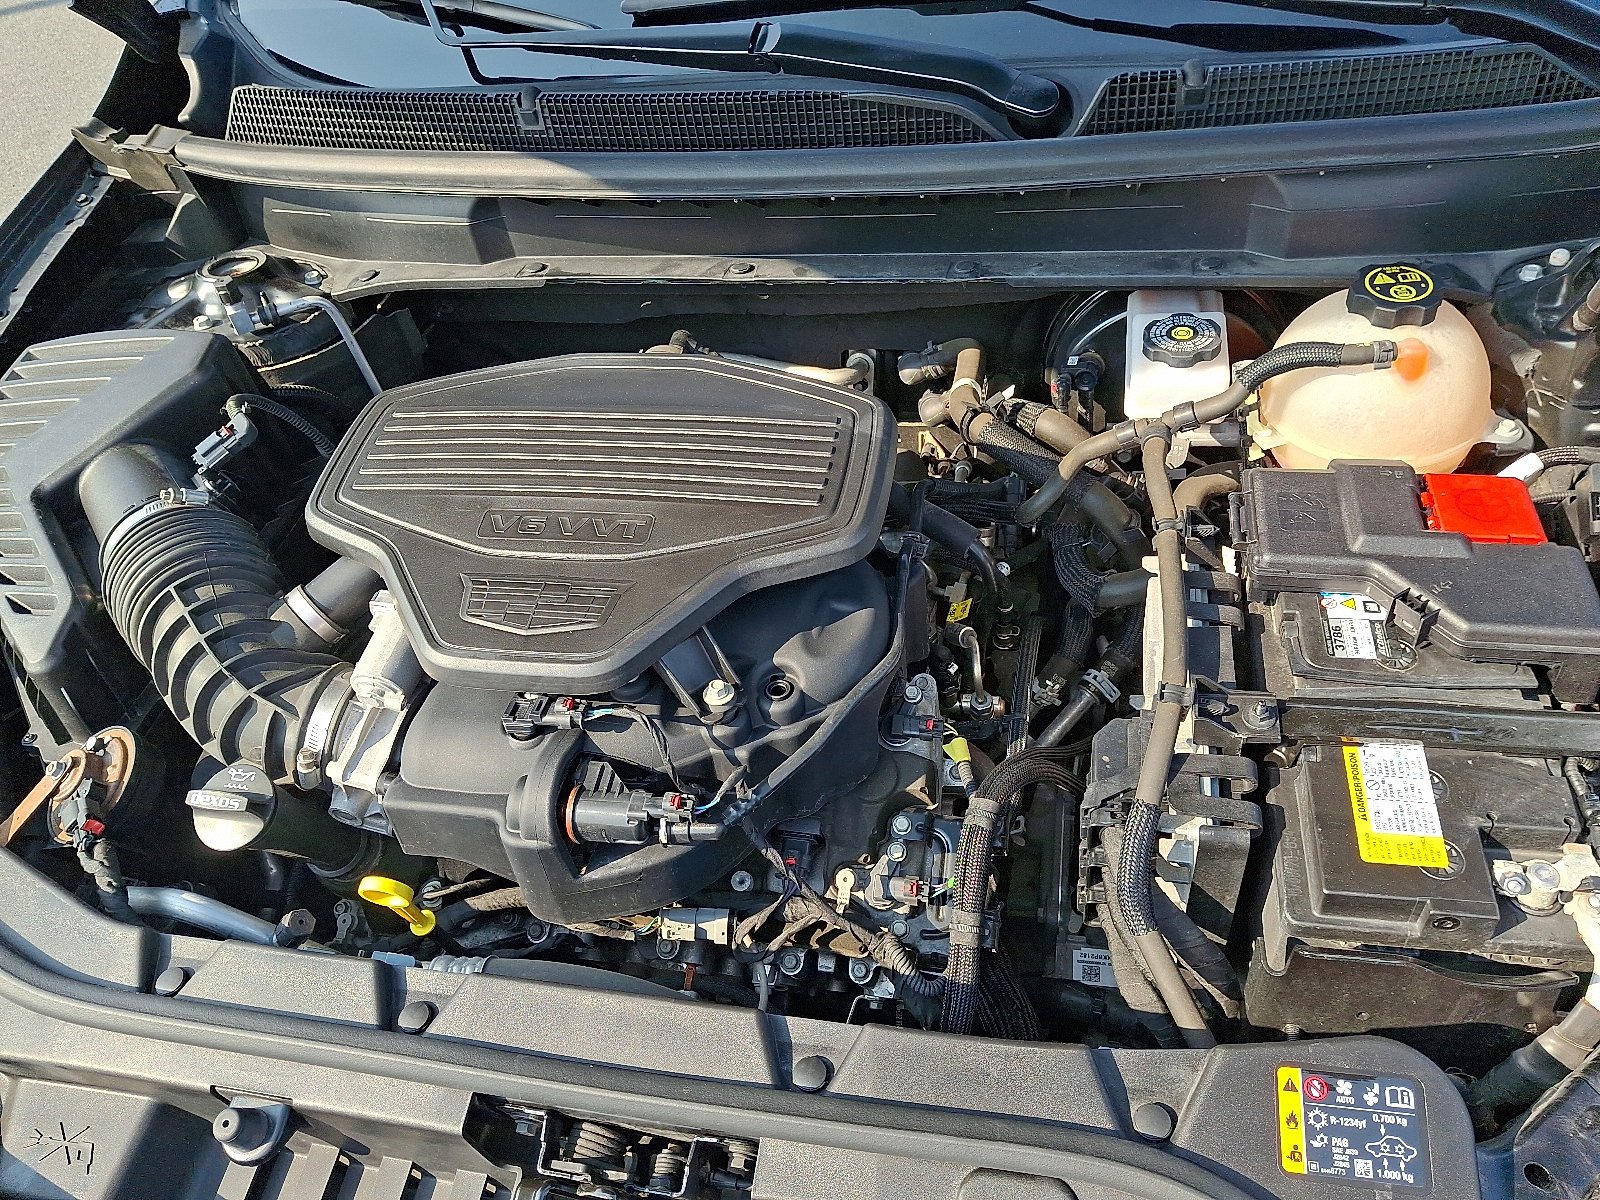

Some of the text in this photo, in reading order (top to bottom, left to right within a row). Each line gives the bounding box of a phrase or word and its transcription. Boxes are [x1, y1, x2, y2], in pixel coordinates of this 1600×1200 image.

[490, 514, 648, 539] V6 VVT
[1331, 625, 1345, 651] 3786
[191, 792, 242, 810] dexos
[1336, 1095, 1355, 1105] AUTO
[1330, 1115, 1367, 1130] R-1234yf
[1373, 1113, 1408, 1127] 0.700 kg
[1331, 1136, 1349, 1148] PAG
[1377, 1168, 1414, 1184] 1.000 kg
